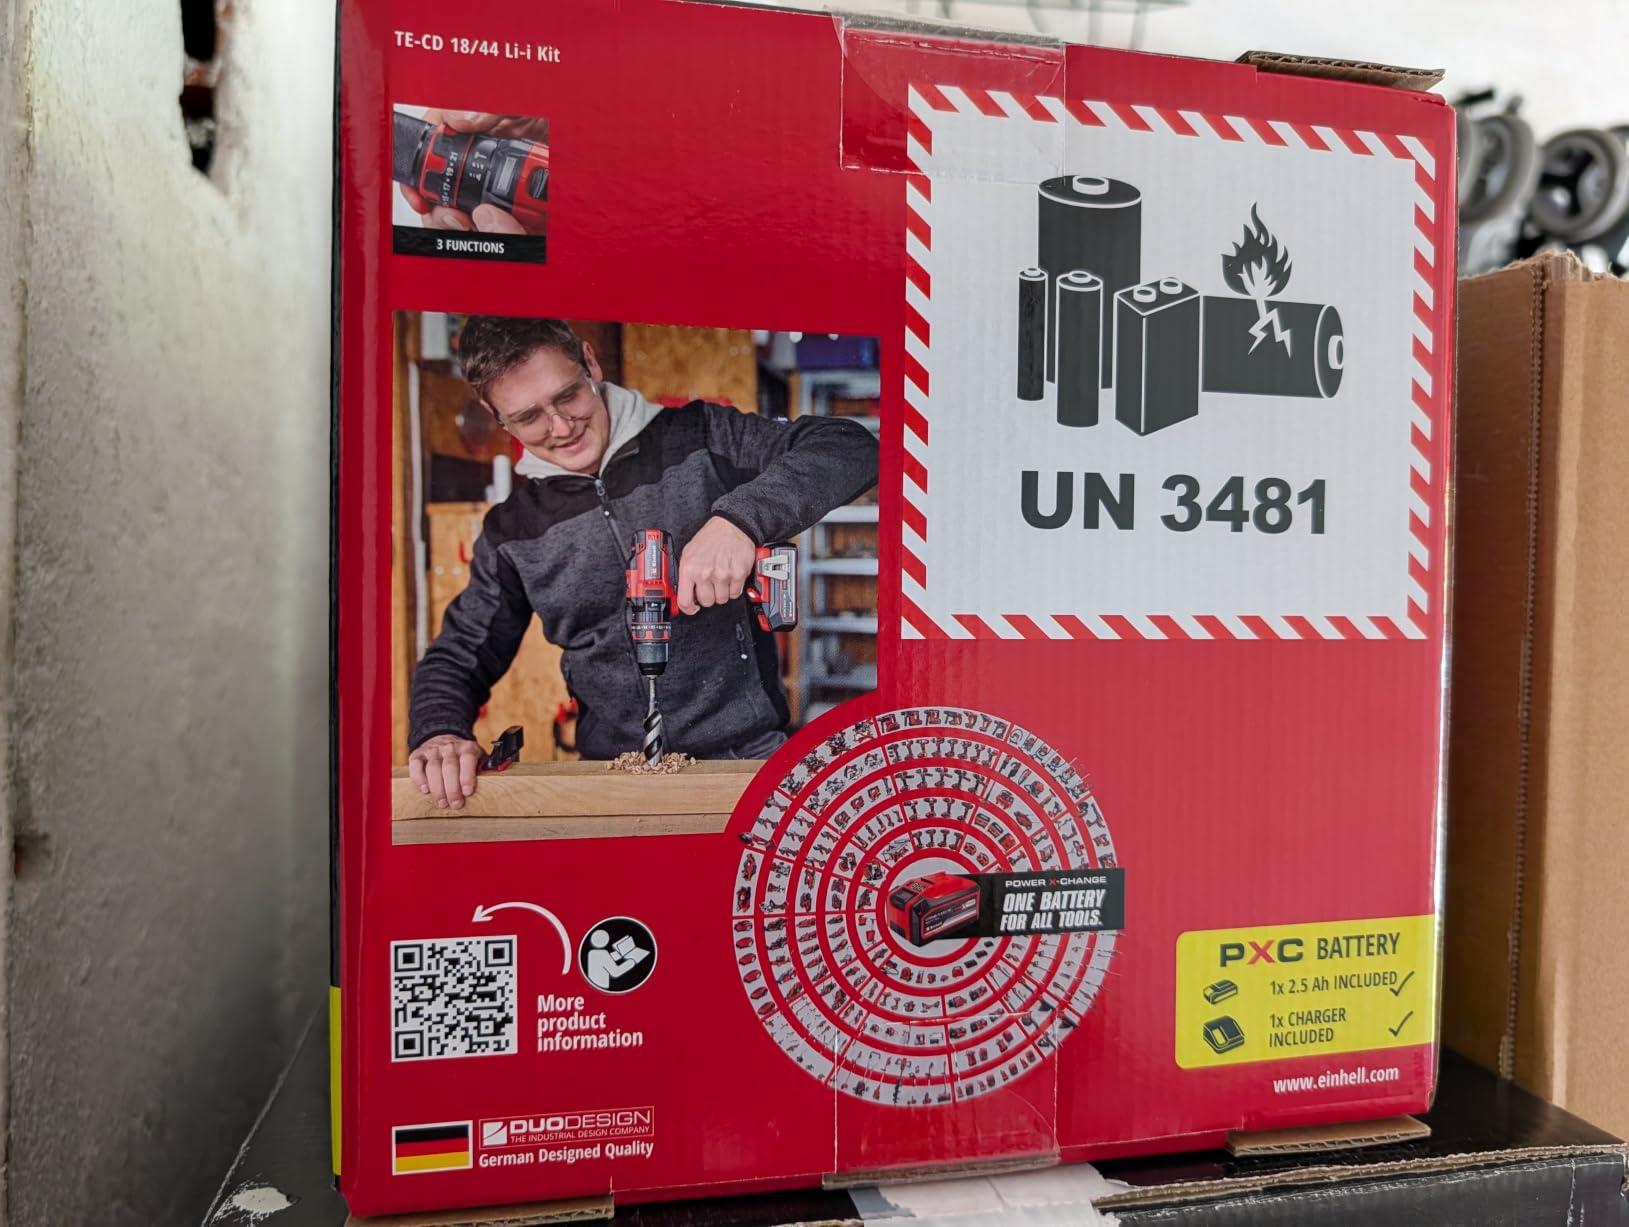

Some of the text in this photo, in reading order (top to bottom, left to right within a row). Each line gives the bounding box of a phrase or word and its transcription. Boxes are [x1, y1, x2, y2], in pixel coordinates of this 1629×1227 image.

[394, 30, 560, 63] TE-CD 18/44 Li-i Kit
[445, 166, 454, 177] 19
[436, 238, 505, 254] 3 FUNCTIONS
[1021, 470, 1326, 535] UN 3481
[1005, 878, 1046, 888] POWER
[1002, 892, 1036, 913] ONE
[1040, 888, 1106, 911] BATTERY
[1000, 909, 1103, 932] FOR ALL TOOLS.
[1219, 932, 1401, 967] PXC BATTERY
[1269, 971, 1398, 995] 1x 2.5 Ah INCLUDED
[537, 994, 585, 1012] More
[537, 1011, 606, 1038] product
[1269, 1007, 1347, 1029] 1x CHARGER
[537, 1029, 643, 1053] information
[1269, 1027, 1334, 1048] INCLUDED
[1273, 1066, 1399, 1093] www.einhell.com
[509, 1110, 650, 1135] DUODESIGN
[510, 1125, 650, 1144] THE INDUSTRIAL DESIGN COMPANY
[478, 1140, 654, 1168] German Designed Quality
